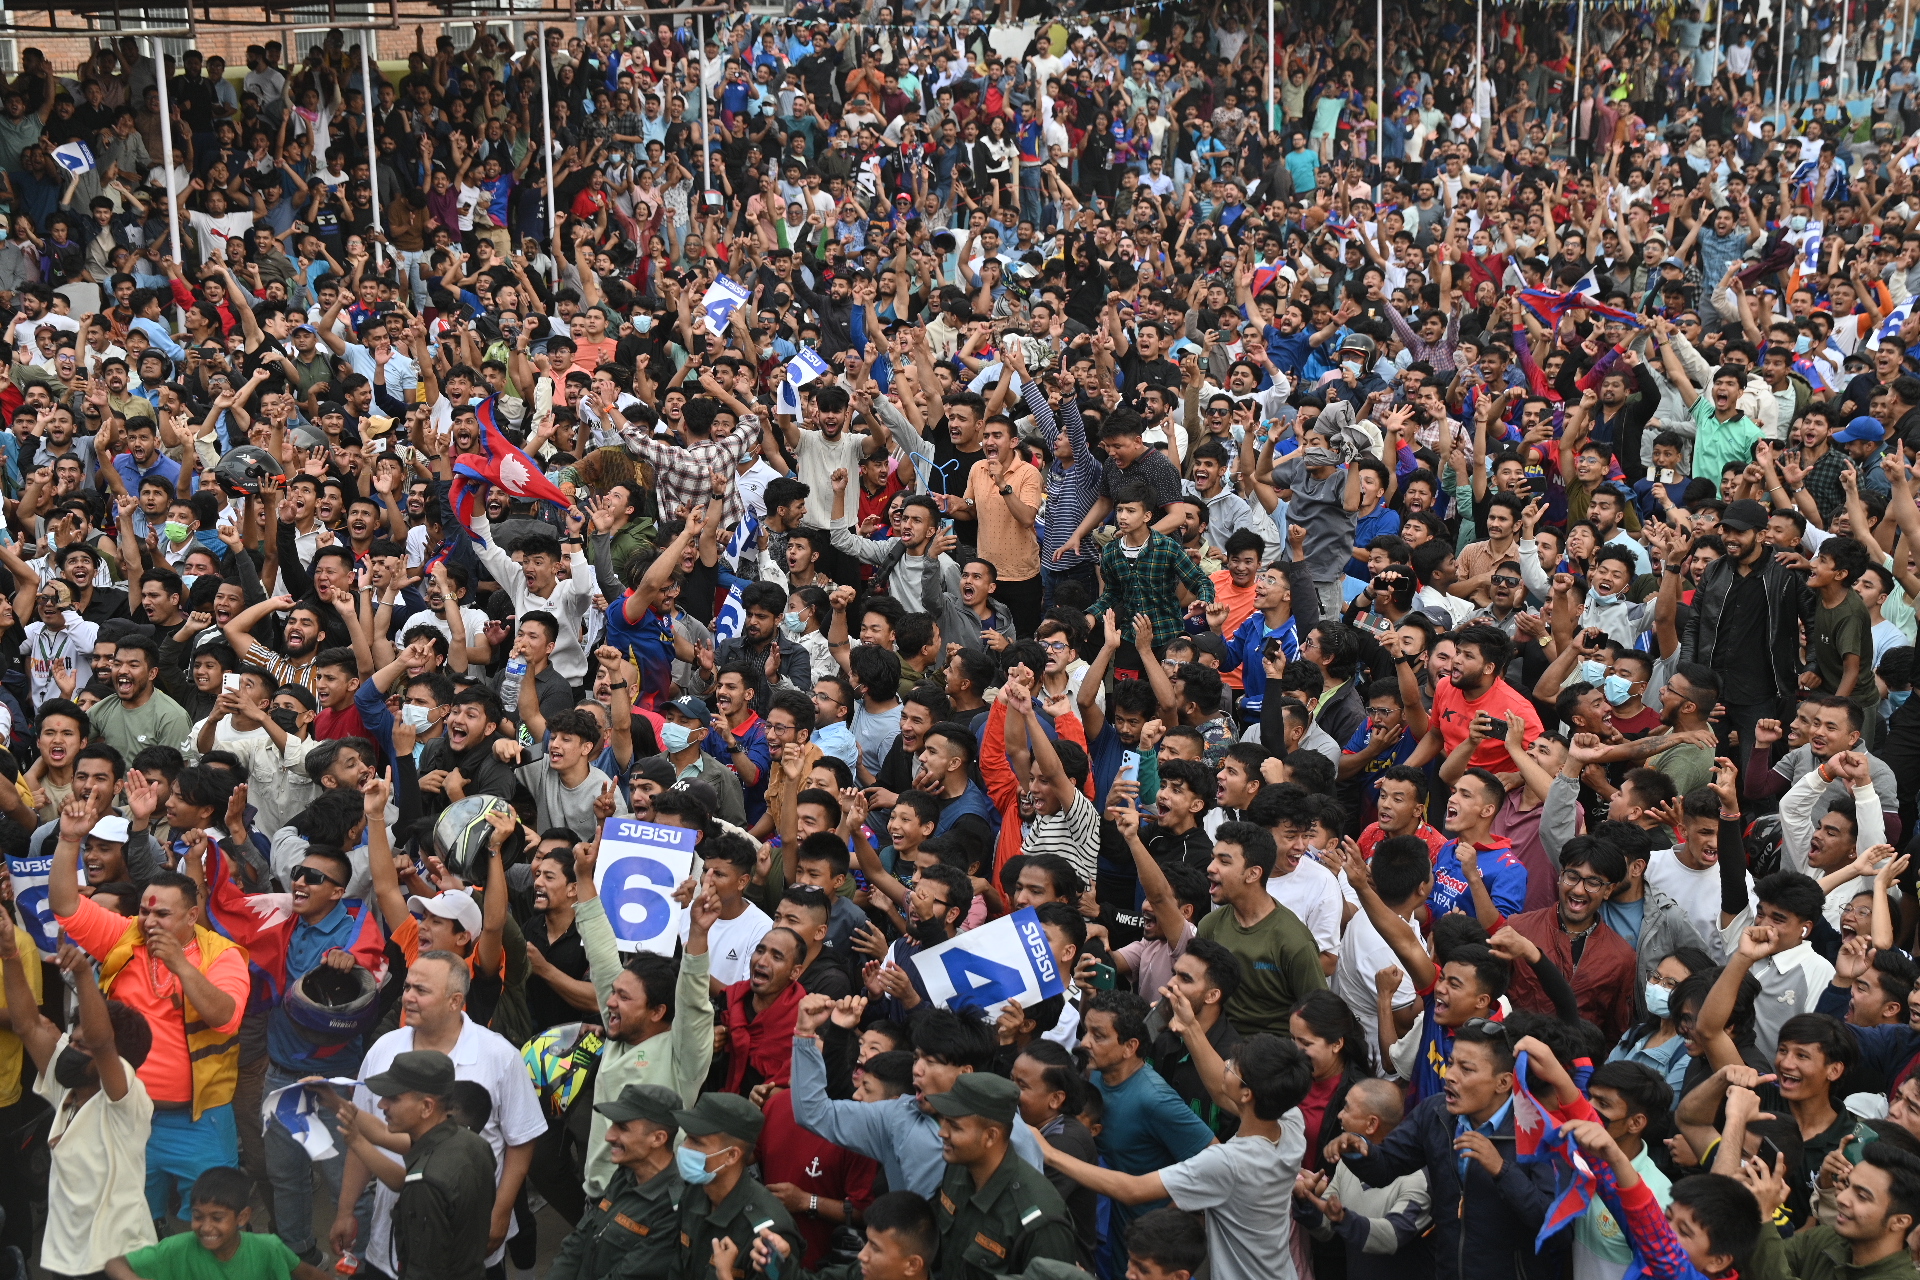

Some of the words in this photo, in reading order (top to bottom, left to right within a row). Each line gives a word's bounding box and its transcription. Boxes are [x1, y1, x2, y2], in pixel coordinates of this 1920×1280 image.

[617, 822, 682, 845] SUBiSU
[12, 858, 54, 874] SUBiS
[600, 856, 675, 942] 6
[1116, 912, 1138, 927] NIKE
[1022, 922, 1056, 983] SUBiSU
[940, 946, 1027, 1011] 4
